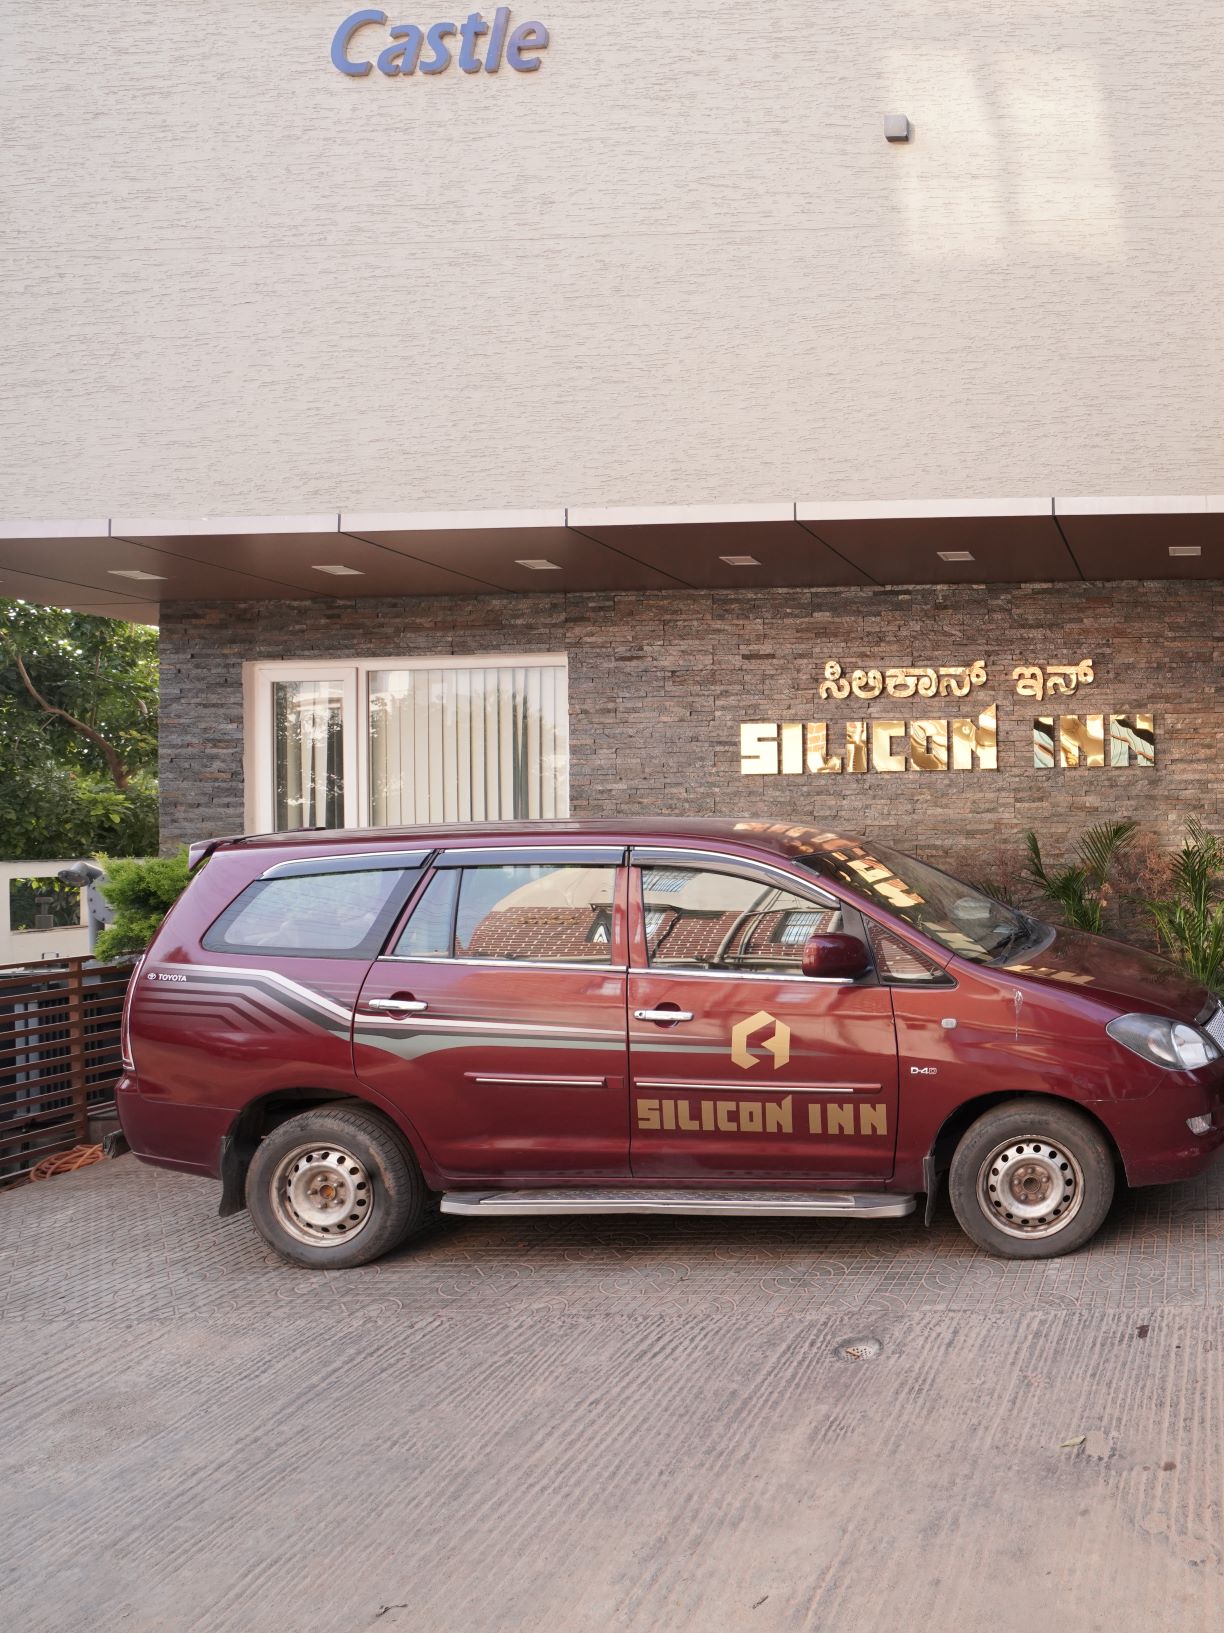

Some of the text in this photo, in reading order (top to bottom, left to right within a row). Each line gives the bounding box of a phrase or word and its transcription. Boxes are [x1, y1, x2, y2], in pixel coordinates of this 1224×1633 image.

[330, 6, 550, 77] Castle
[819, 658, 1095, 701] ಸಿಲಿಕಾನ್ ಇನ್
[740, 703, 1155, 775] SILICON INN
[158, 973, 187, 982] TOYOTA
[910, 1066, 937, 1075] D-4D
[637, 1094, 888, 1136] SILICON INN
